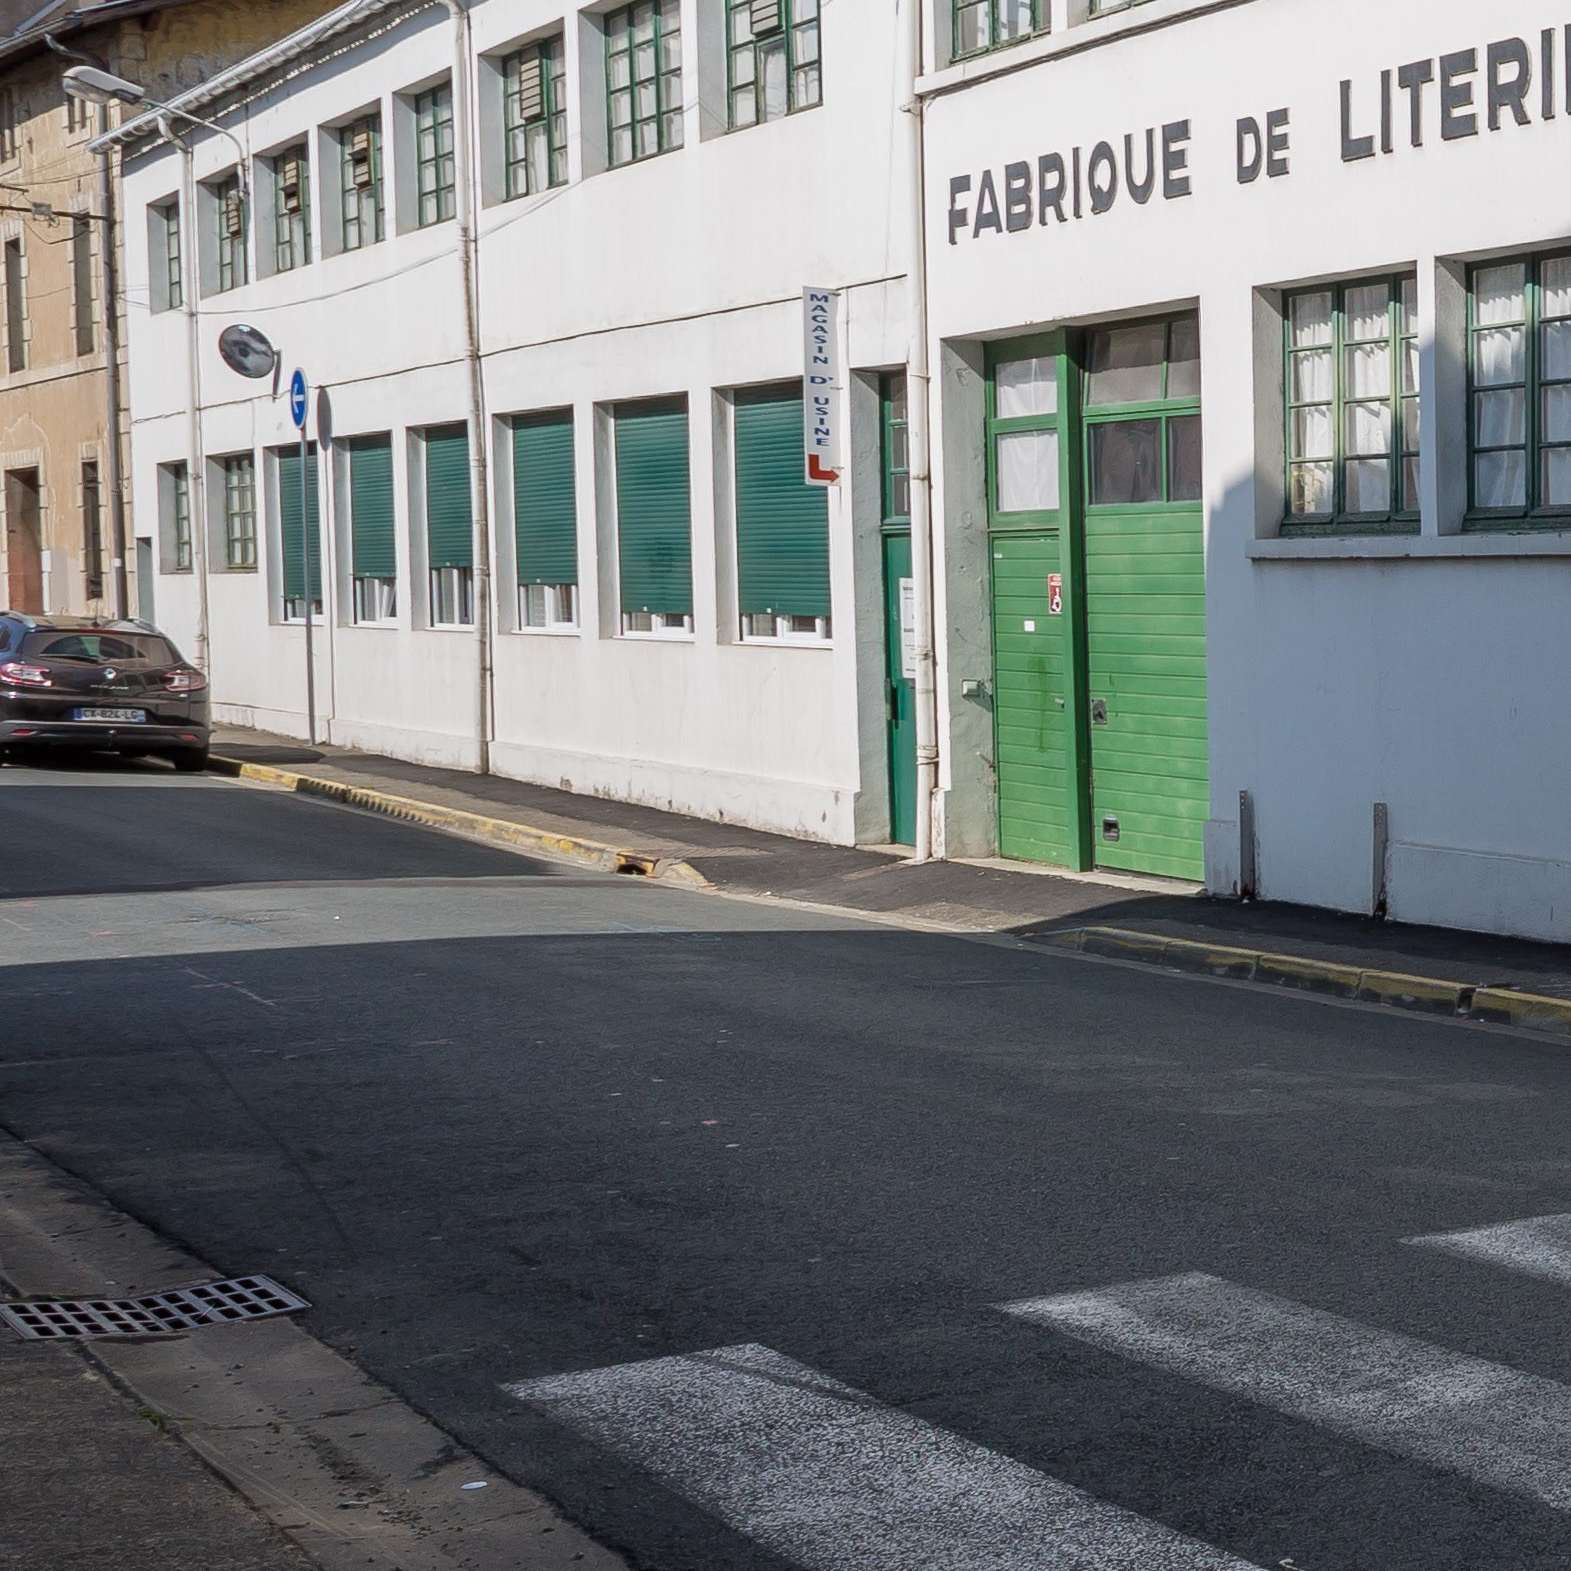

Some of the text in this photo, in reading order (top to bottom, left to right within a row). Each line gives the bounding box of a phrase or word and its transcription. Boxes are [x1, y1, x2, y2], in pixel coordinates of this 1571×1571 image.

[948, 118, 1193, 246] FABRIQUE
[1236, 107, 1290, 185] DE
[809, 292, 831, 365] MAGASIN
[813, 396, 831, 447] USINE
